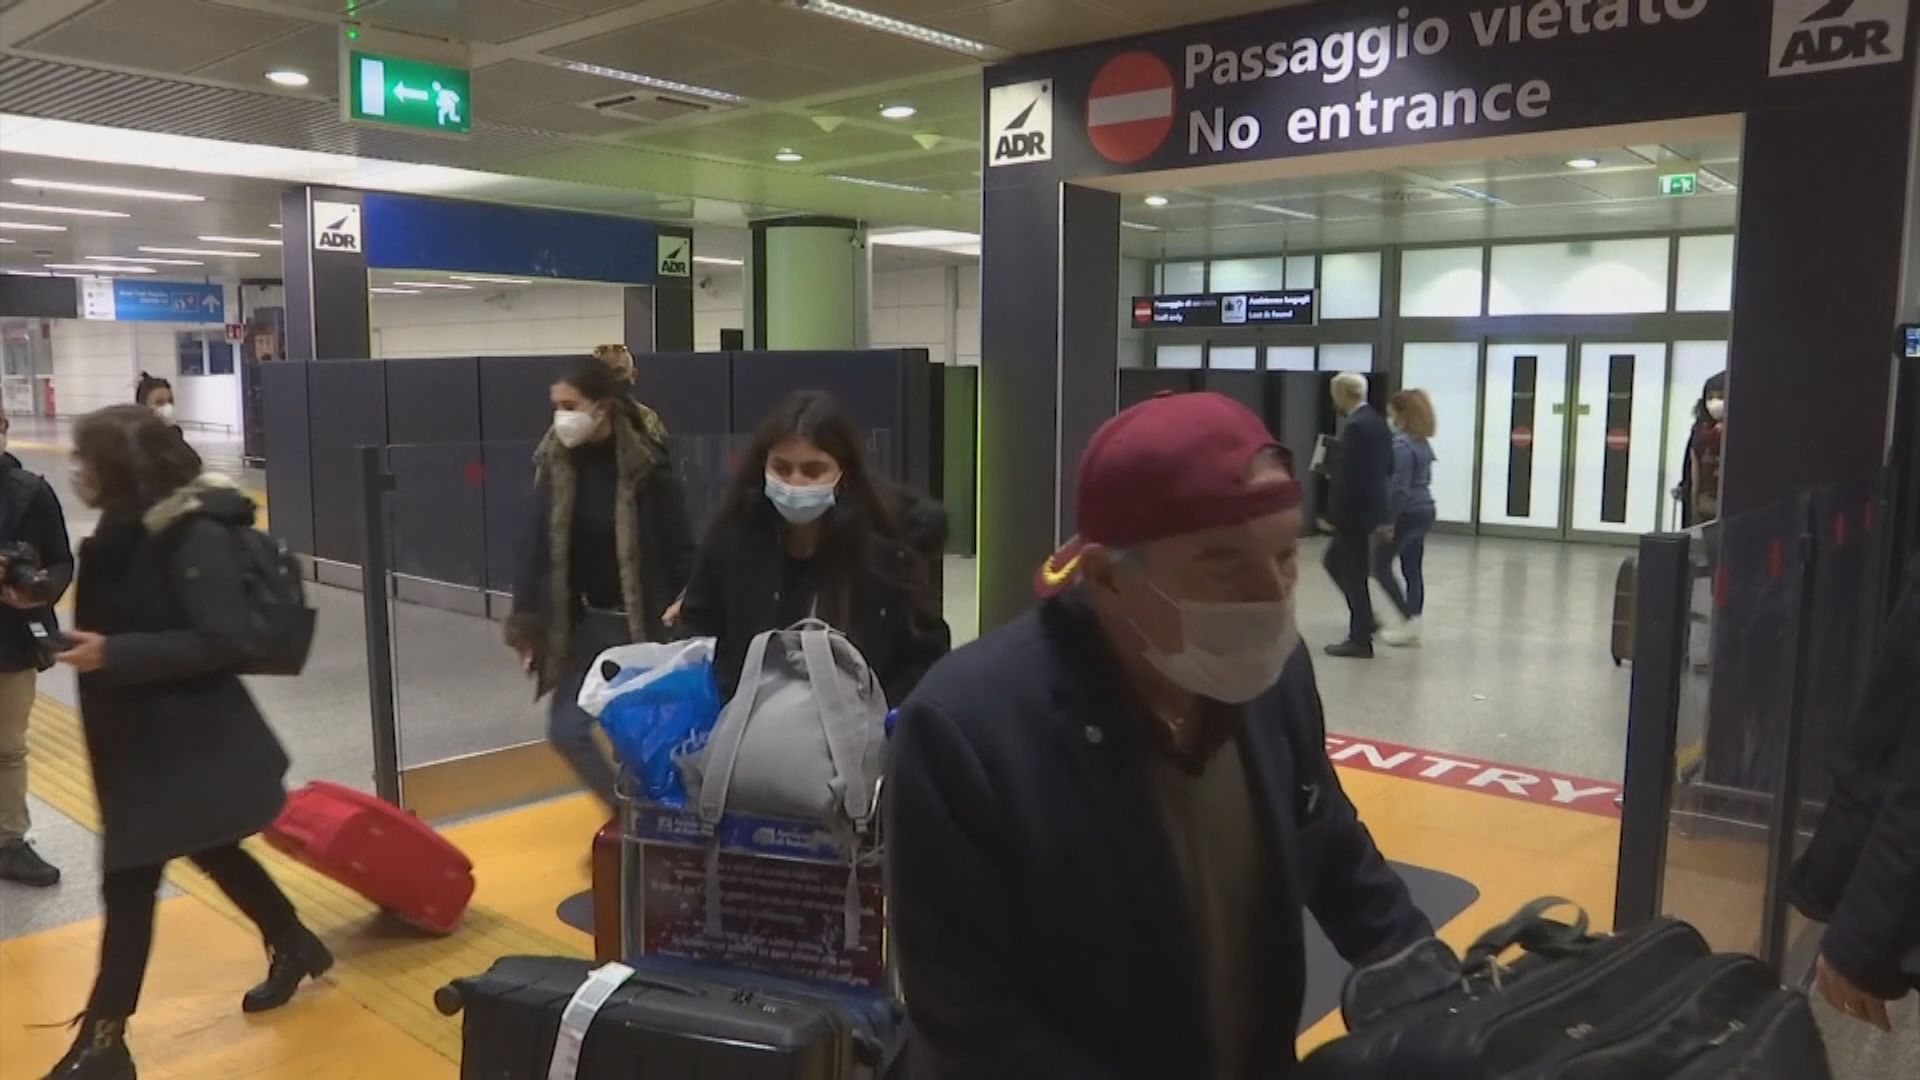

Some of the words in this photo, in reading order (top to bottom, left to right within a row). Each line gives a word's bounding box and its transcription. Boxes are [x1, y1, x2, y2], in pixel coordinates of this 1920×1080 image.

[1184, 7, 1450, 89] Passaggio
[1468, 0, 1708, 47] vietato
[1779, 19, 1892, 69] ADR
[1188, 107, 1261, 155] No
[1286, 78, 1552, 144] entrance
[994, 130, 1047, 161] ADR
[319, 232, 357, 249] ADR
[661, 260, 687, 275] ADR
